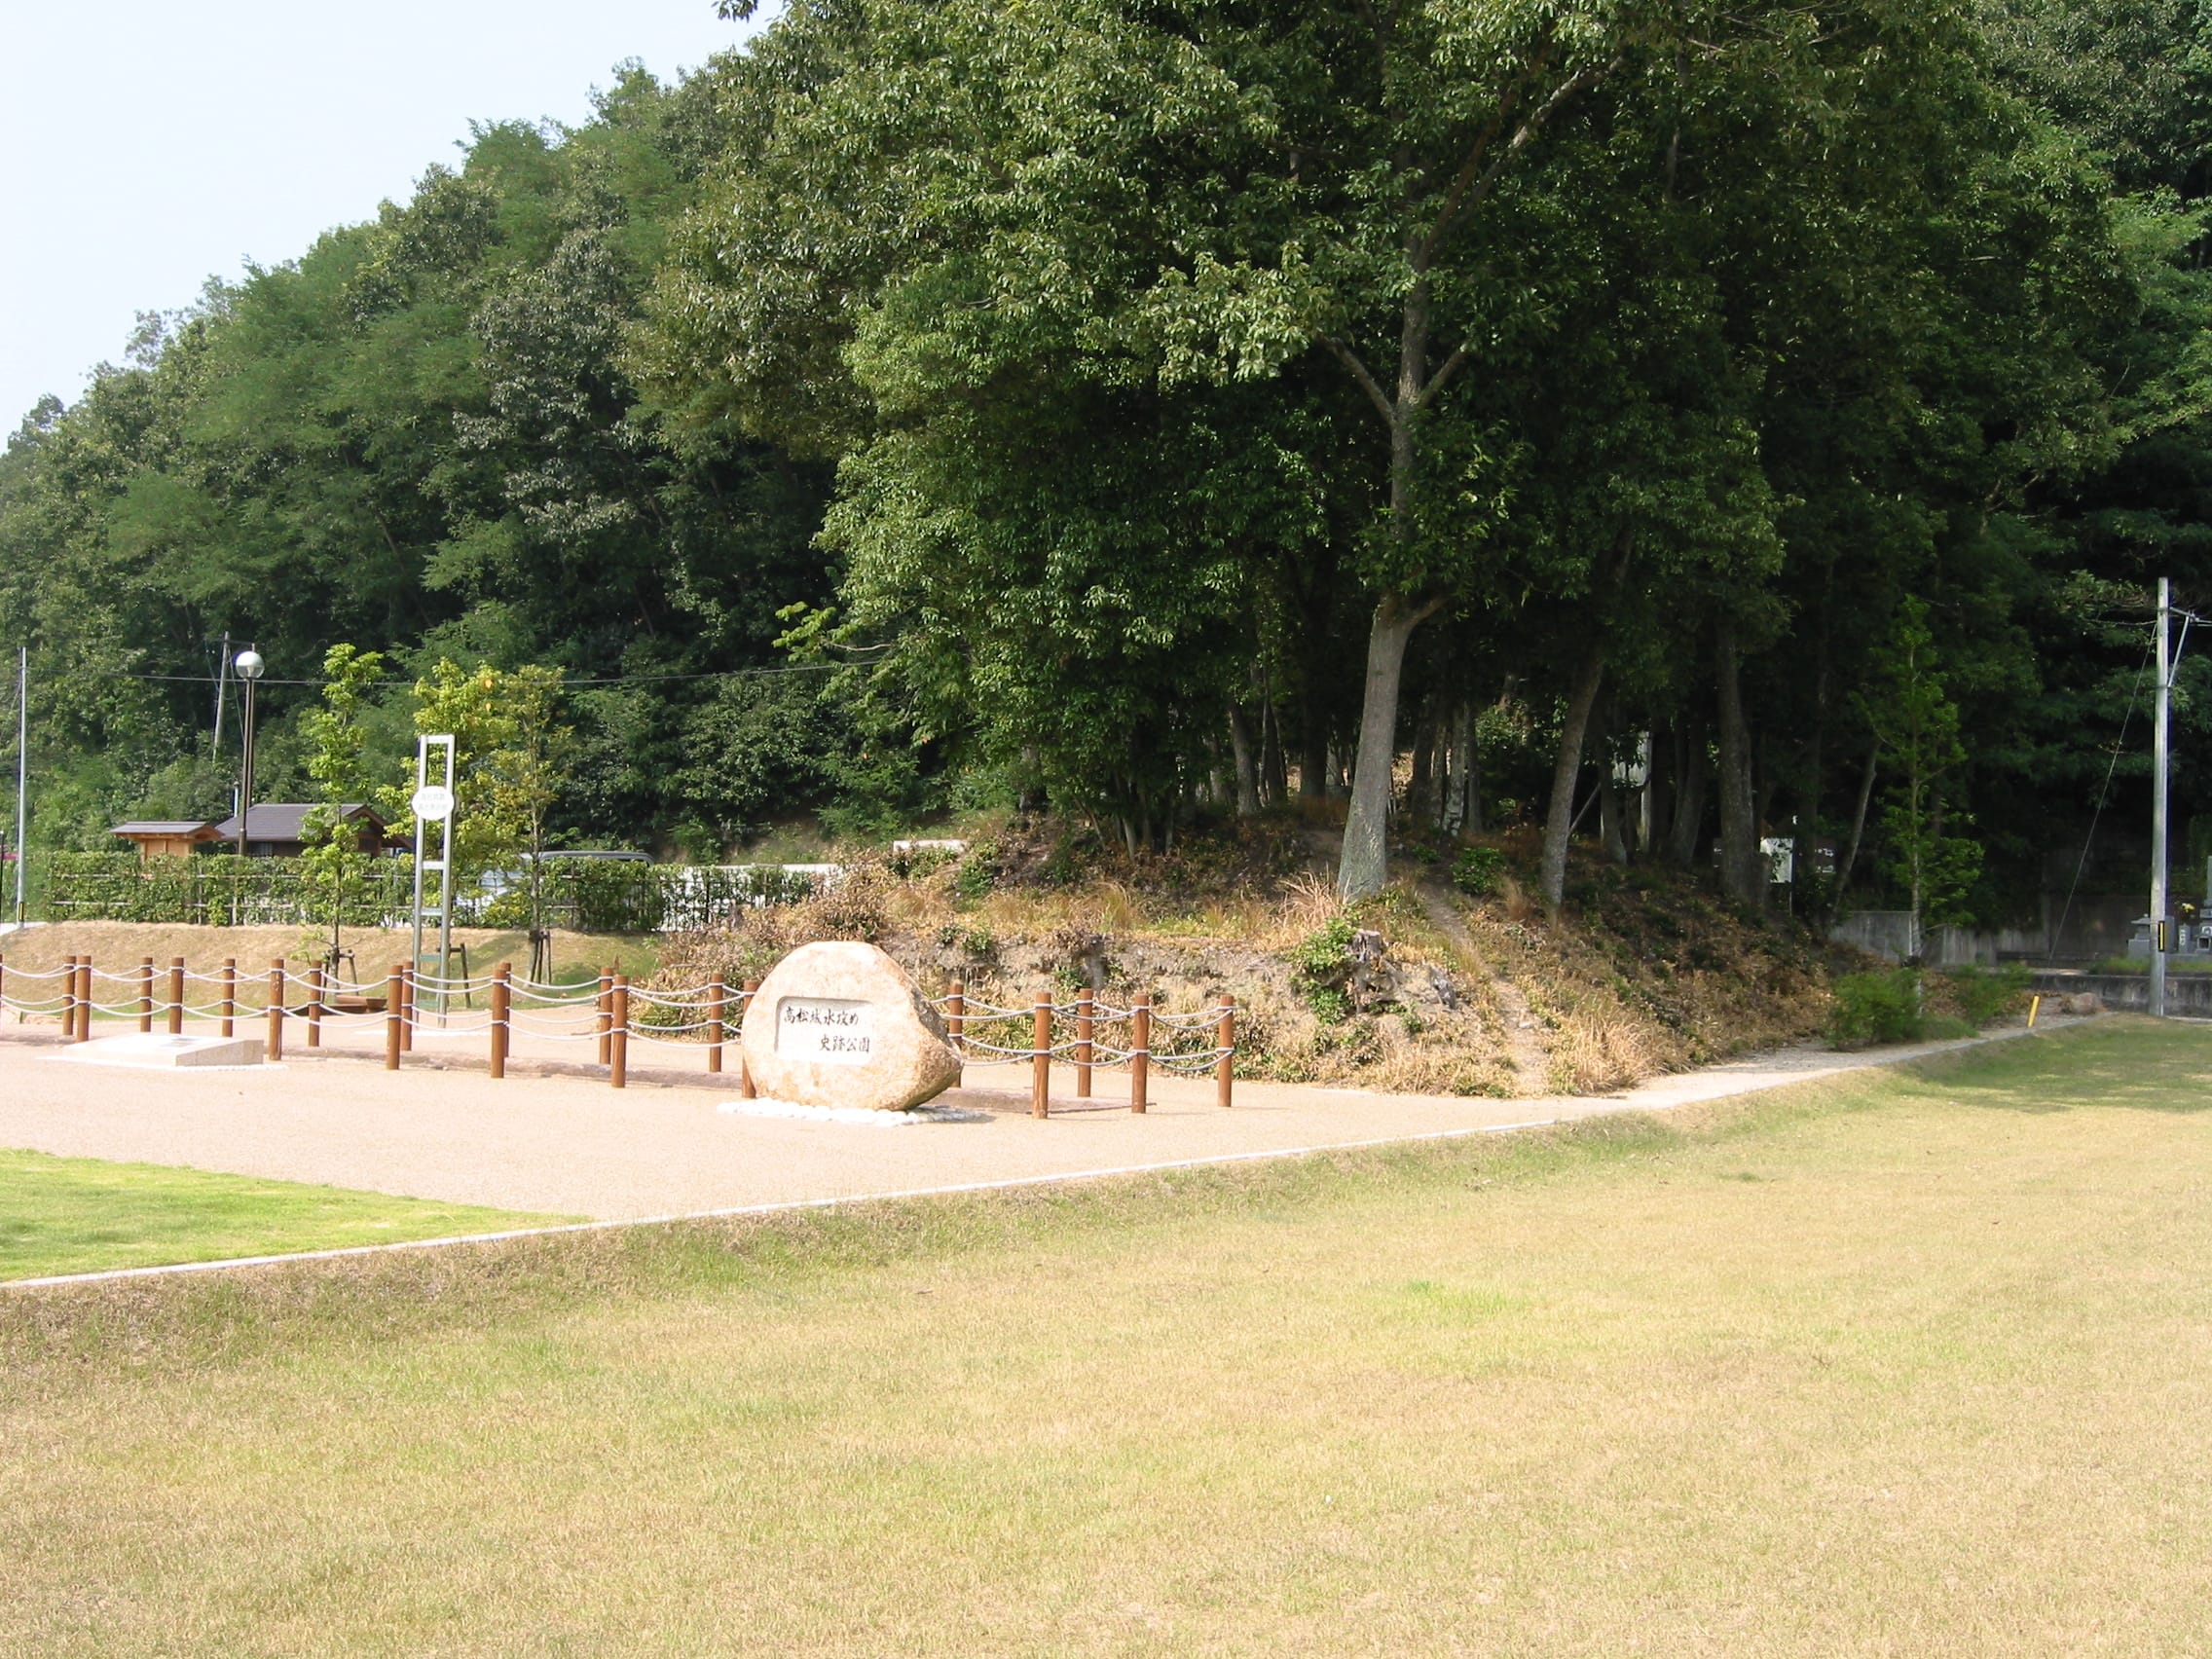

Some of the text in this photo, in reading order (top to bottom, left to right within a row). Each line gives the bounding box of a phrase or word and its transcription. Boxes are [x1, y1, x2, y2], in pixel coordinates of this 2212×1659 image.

[785, 1007, 859, 1026] 高松城水攻め
[820, 1034, 870, 1052] 史跡公園
